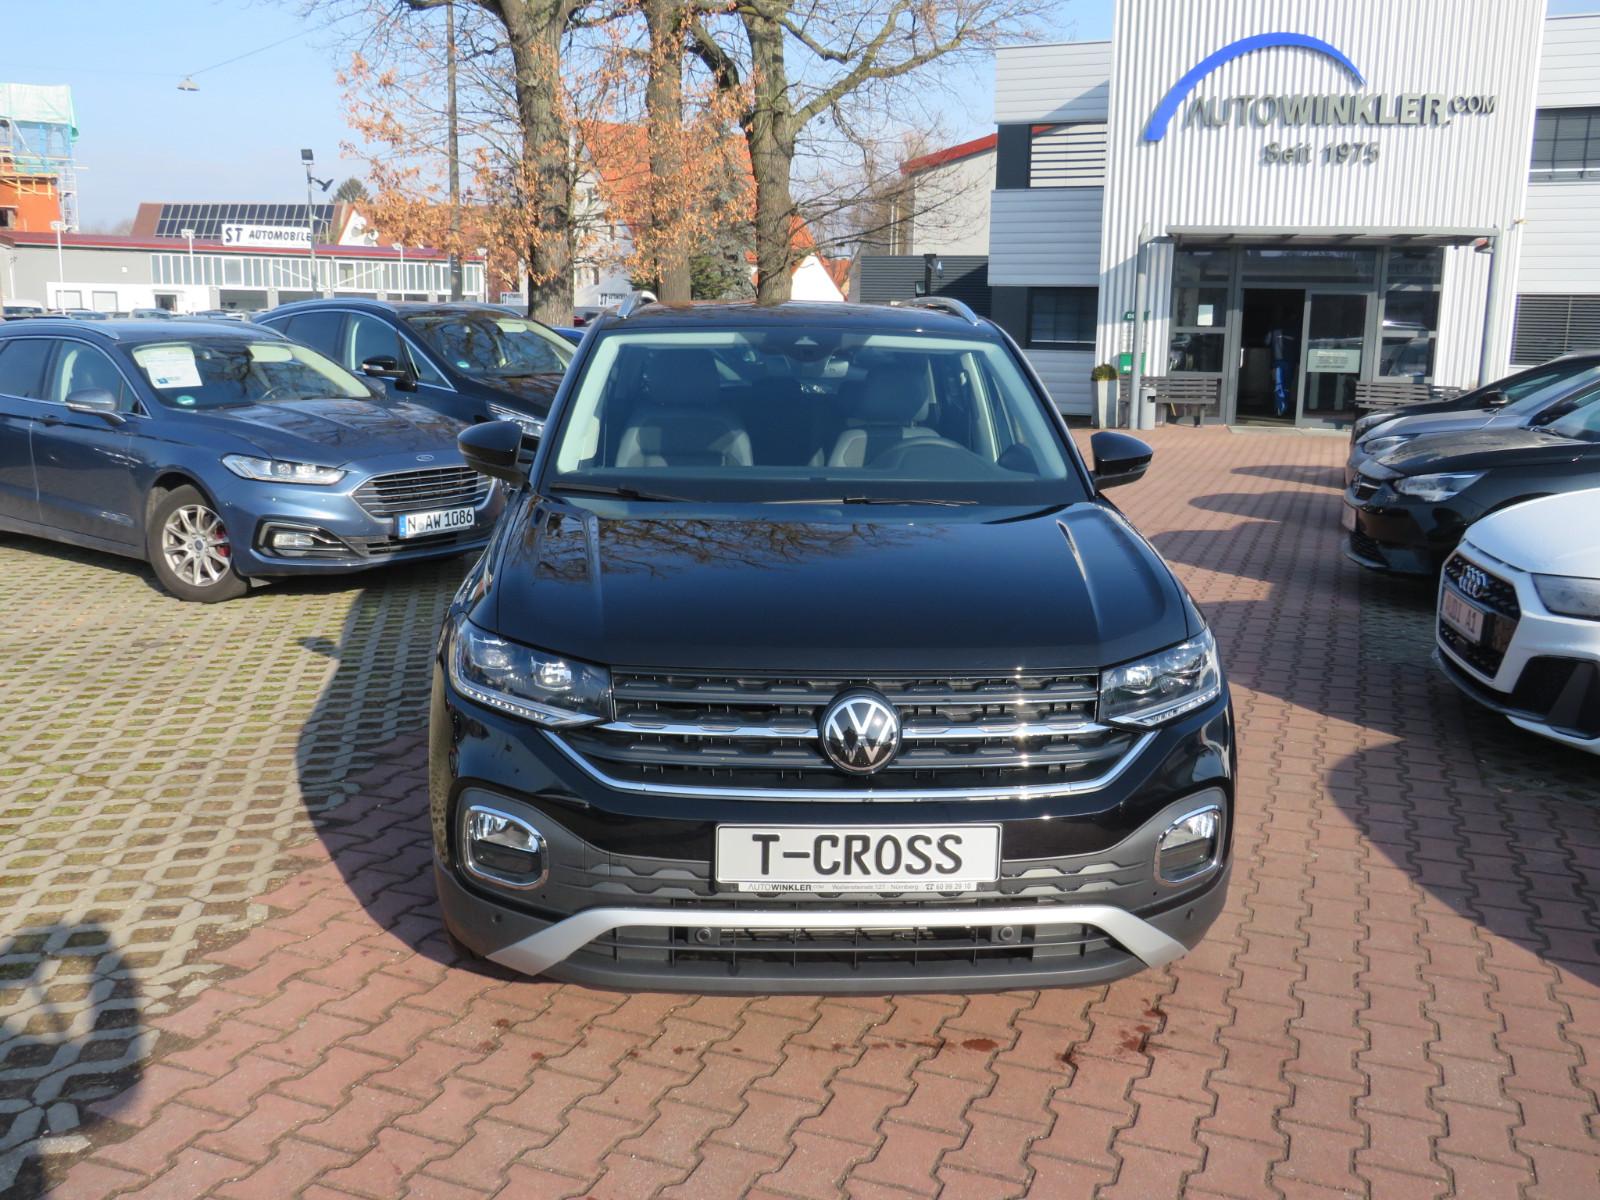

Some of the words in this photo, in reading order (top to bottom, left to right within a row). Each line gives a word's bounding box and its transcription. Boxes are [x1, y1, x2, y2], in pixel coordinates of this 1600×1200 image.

[1263, 142, 1312, 164] Seit
[1322, 141, 1381, 164] 1975
[225, 227, 243, 243] ST
[248, 230, 312, 242] AUTOMOBILE
[407, 516, 416, 530] N
[425, 514, 441, 530] AW
[444, 509, 473, 527] 1086
[752, 833, 963, 875] T-CROSS
